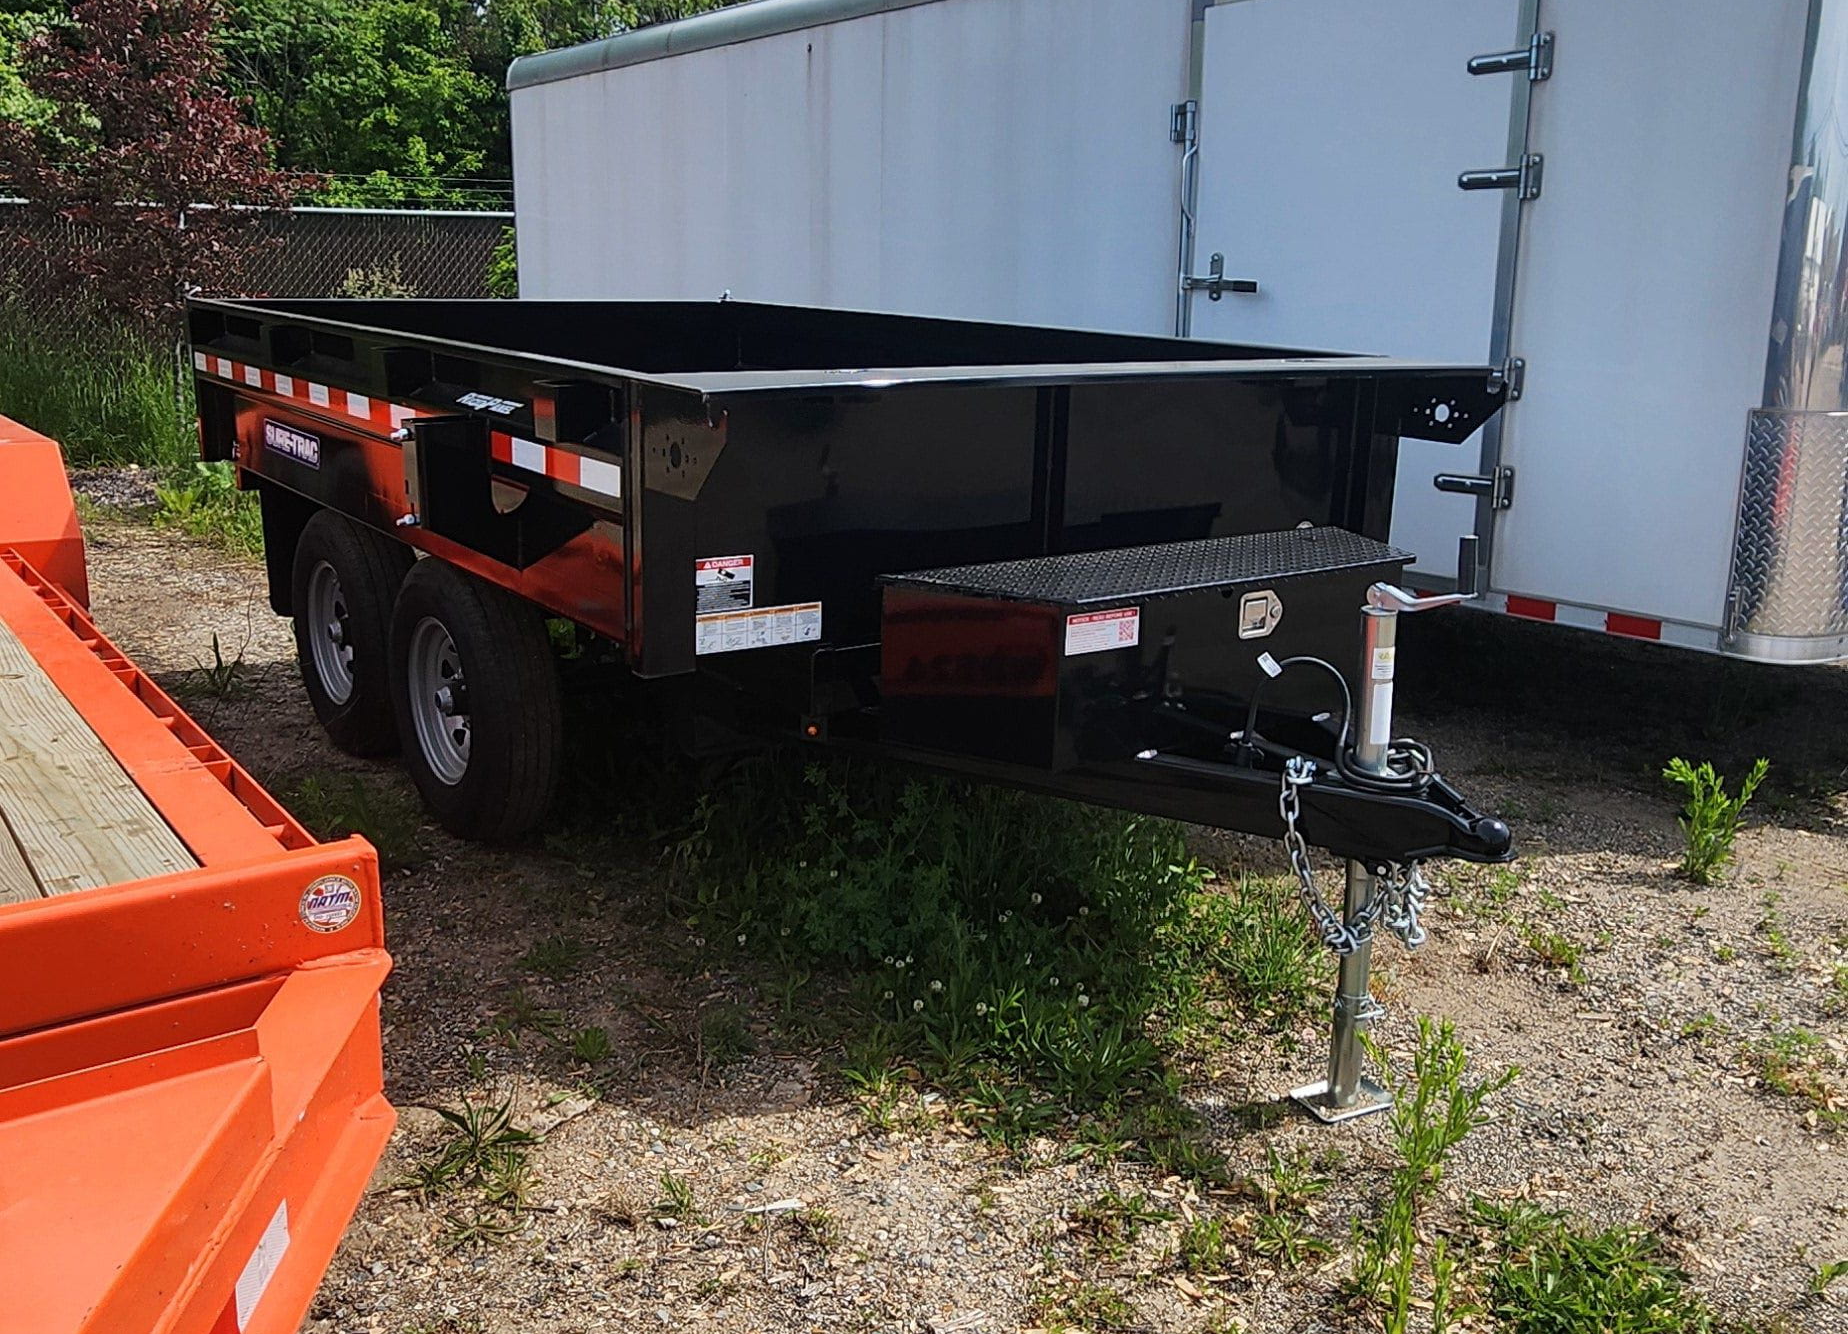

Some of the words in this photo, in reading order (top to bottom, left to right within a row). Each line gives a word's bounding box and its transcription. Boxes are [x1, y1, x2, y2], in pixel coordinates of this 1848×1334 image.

[265, 423, 318, 463] SURE-TRAC
[711, 559, 743, 568] DANGER
[308, 891, 350, 910] NATM
